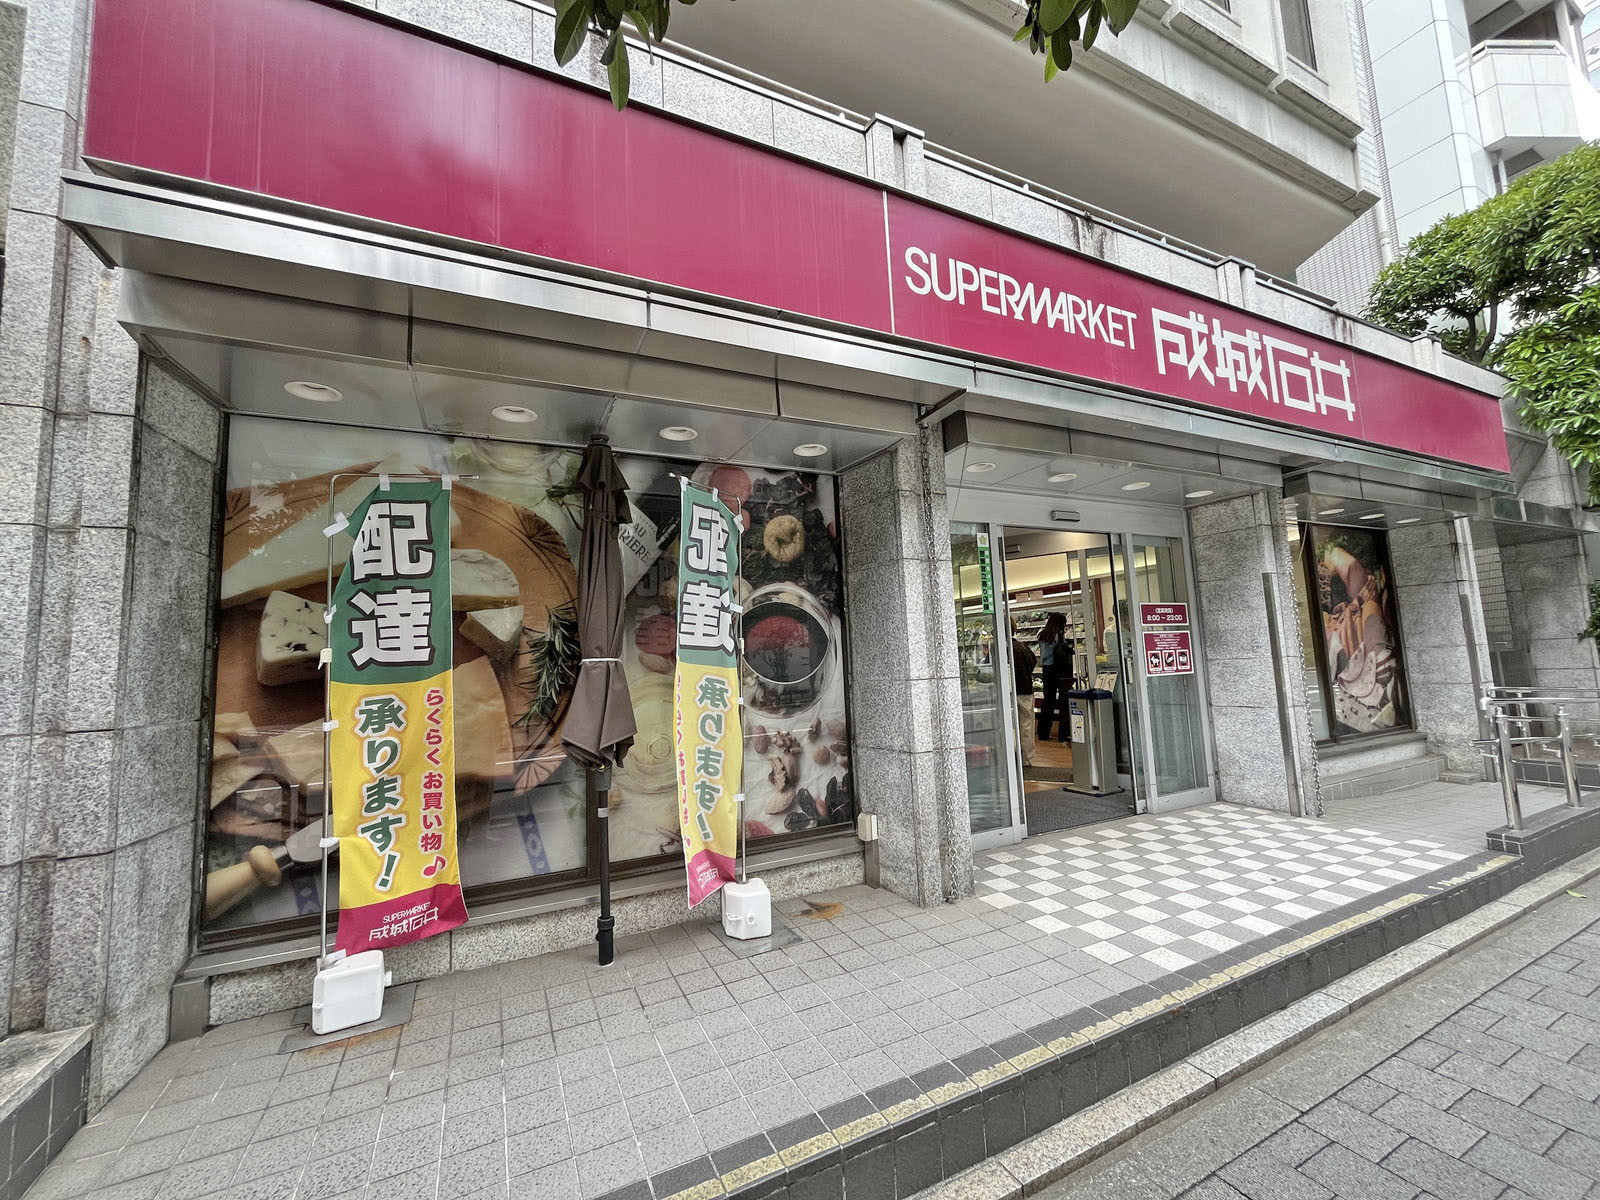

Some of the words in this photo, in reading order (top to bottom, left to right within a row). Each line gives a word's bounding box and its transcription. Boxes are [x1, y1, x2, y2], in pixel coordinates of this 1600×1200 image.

[904, 246, 1138, 350] SUPERMARKET
[1151, 306, 1356, 422] 成城石井
[349, 500, 435, 670] 配達
[368, 907, 439, 941] 成城石井
